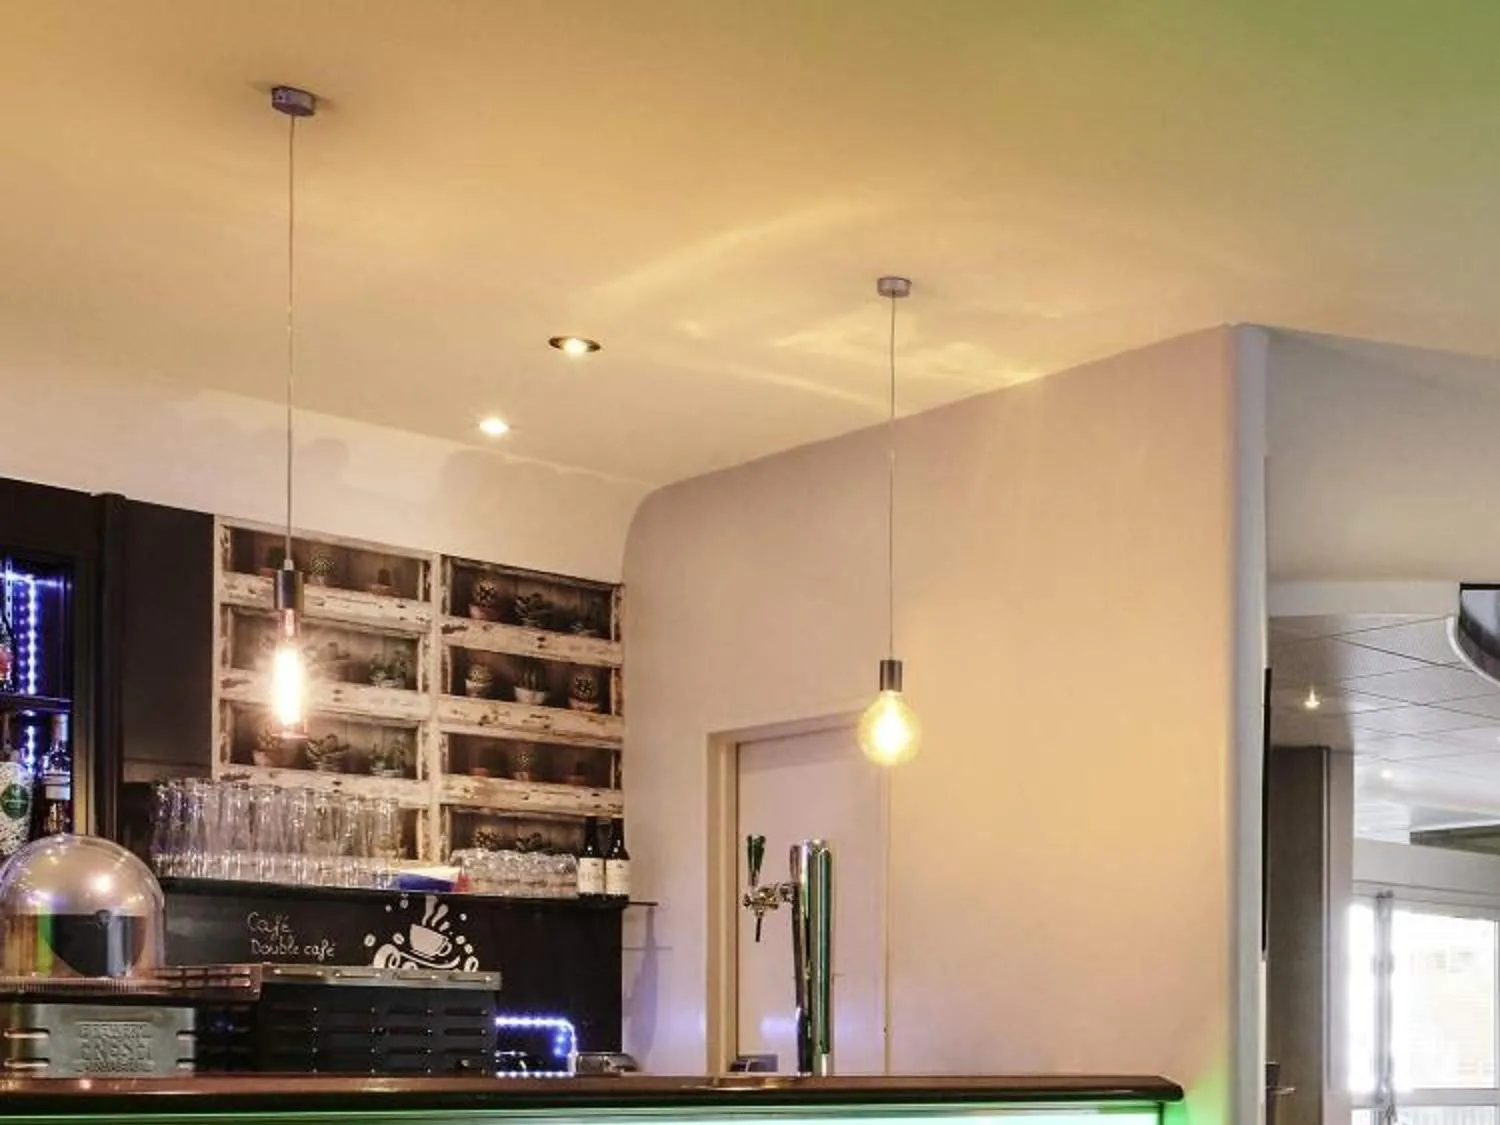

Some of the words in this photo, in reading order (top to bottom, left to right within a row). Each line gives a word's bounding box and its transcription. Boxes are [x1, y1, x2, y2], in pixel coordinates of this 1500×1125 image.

[247, 912, 290, 941] Café
[250, 935, 299, 956] Double
[303, 938, 336, 962] café
